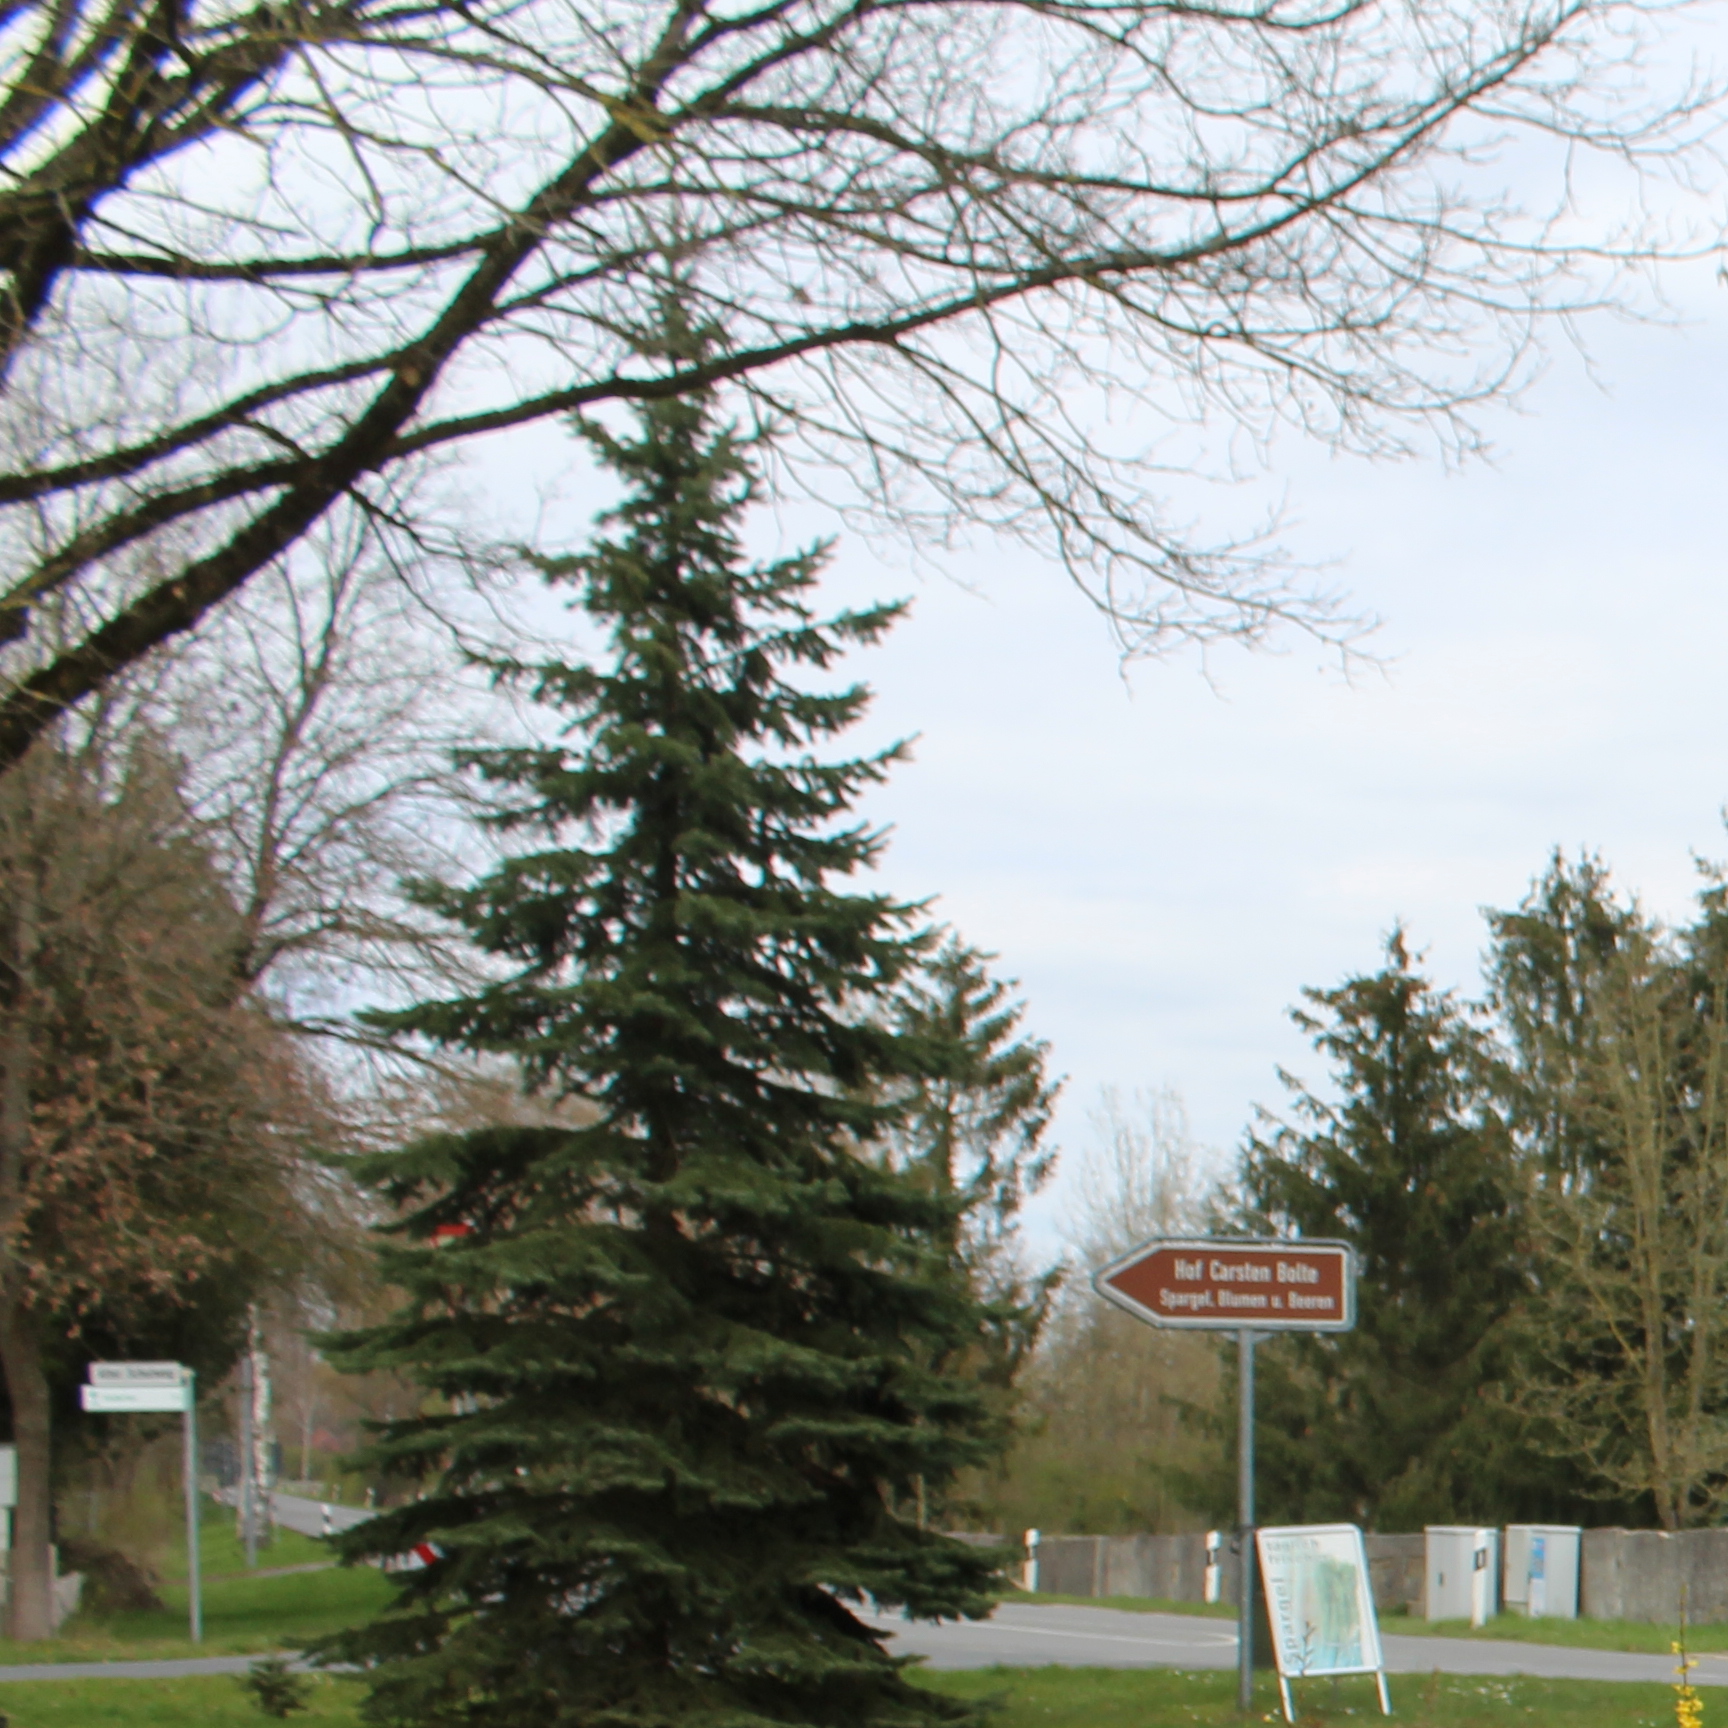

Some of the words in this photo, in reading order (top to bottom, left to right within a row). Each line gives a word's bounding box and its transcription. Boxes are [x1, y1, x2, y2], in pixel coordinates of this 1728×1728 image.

[1174, 1258, 1202, 1280] Hof
[1209, 1259, 1271, 1282] Carsten
[1277, 1261, 1319, 1283] Bolte
[1217, 1289, 1268, 1309] Blumen
[1271, 1294, 1284, 1309] u.
[1288, 1291, 1334, 1309] Beeren
